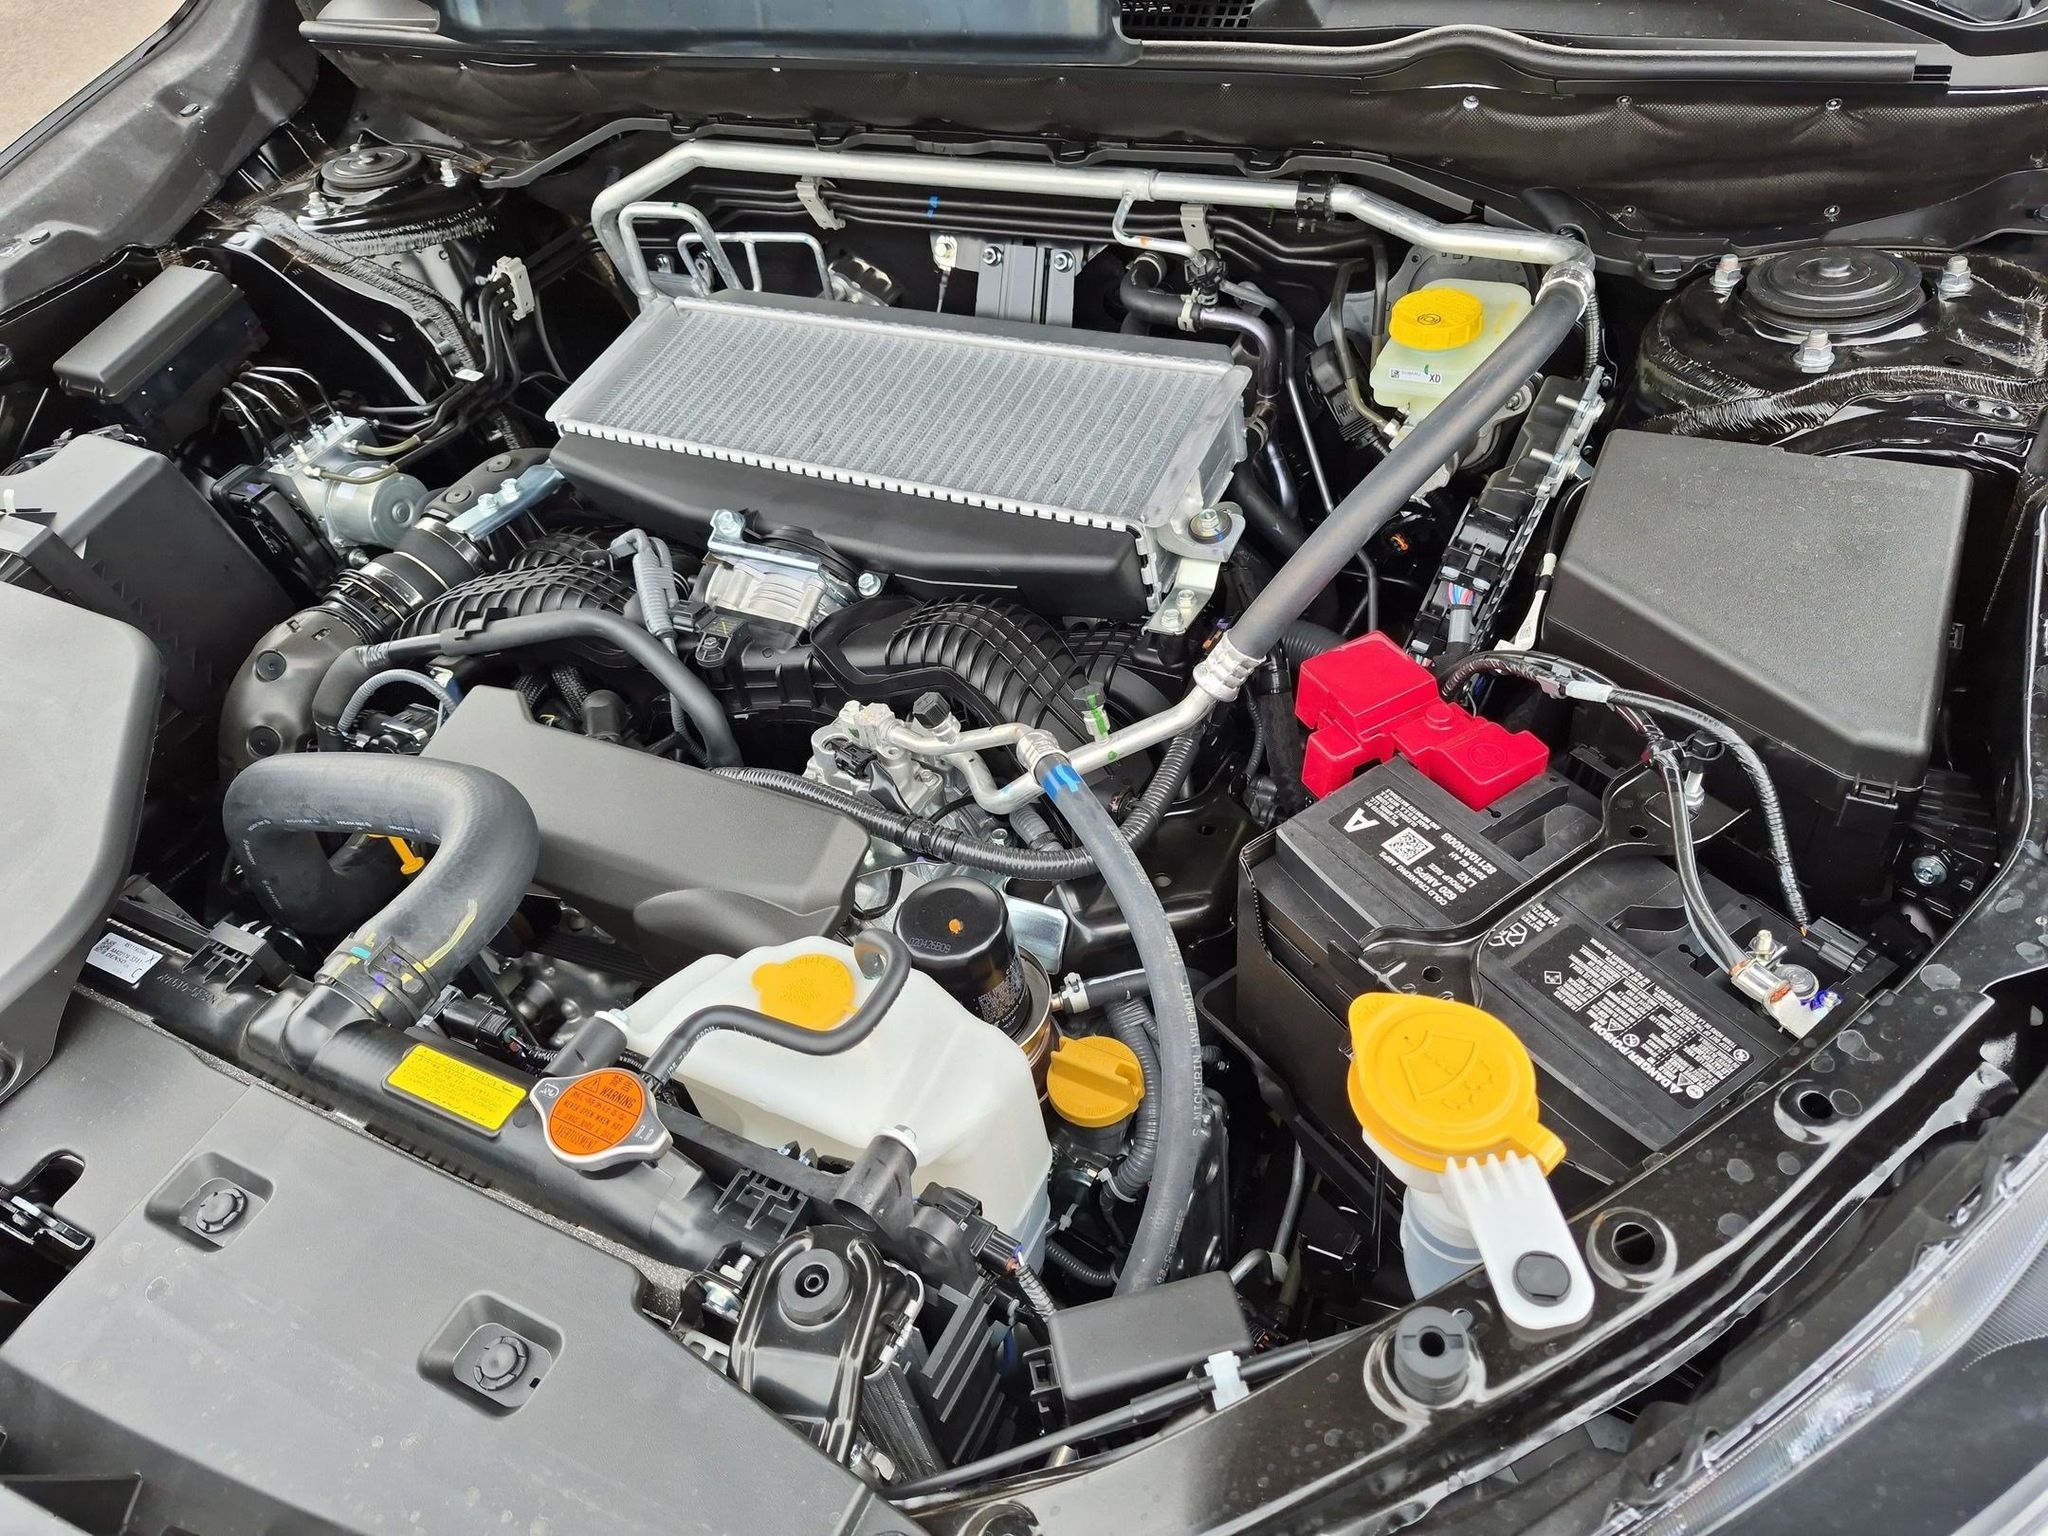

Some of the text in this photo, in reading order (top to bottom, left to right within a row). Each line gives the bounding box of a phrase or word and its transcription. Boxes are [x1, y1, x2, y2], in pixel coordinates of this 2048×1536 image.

[1429, 374, 1441, 383] XD
[1343, 807, 1379, 832] A
[1441, 832, 1496, 874] 82110AN00B
[1448, 851, 1462, 860] AH
[1378, 850, 1447, 905] COLD CRANKING AMPS
[1427, 862, 1466, 893] GROUP SIZE
[1455, 871, 1477, 887] LN2
[1466, 864, 1487, 880] 20HR
[1413, 866, 1457, 900] 620 AMPS
[104, 952, 126, 963] DENSO
[144, 954, 156, 964] X
[130, 967, 142, 978] C
[1589, 1022, 1671, 1086] DANGER/POISON
[599, 1086, 636, 1108] WARNING
